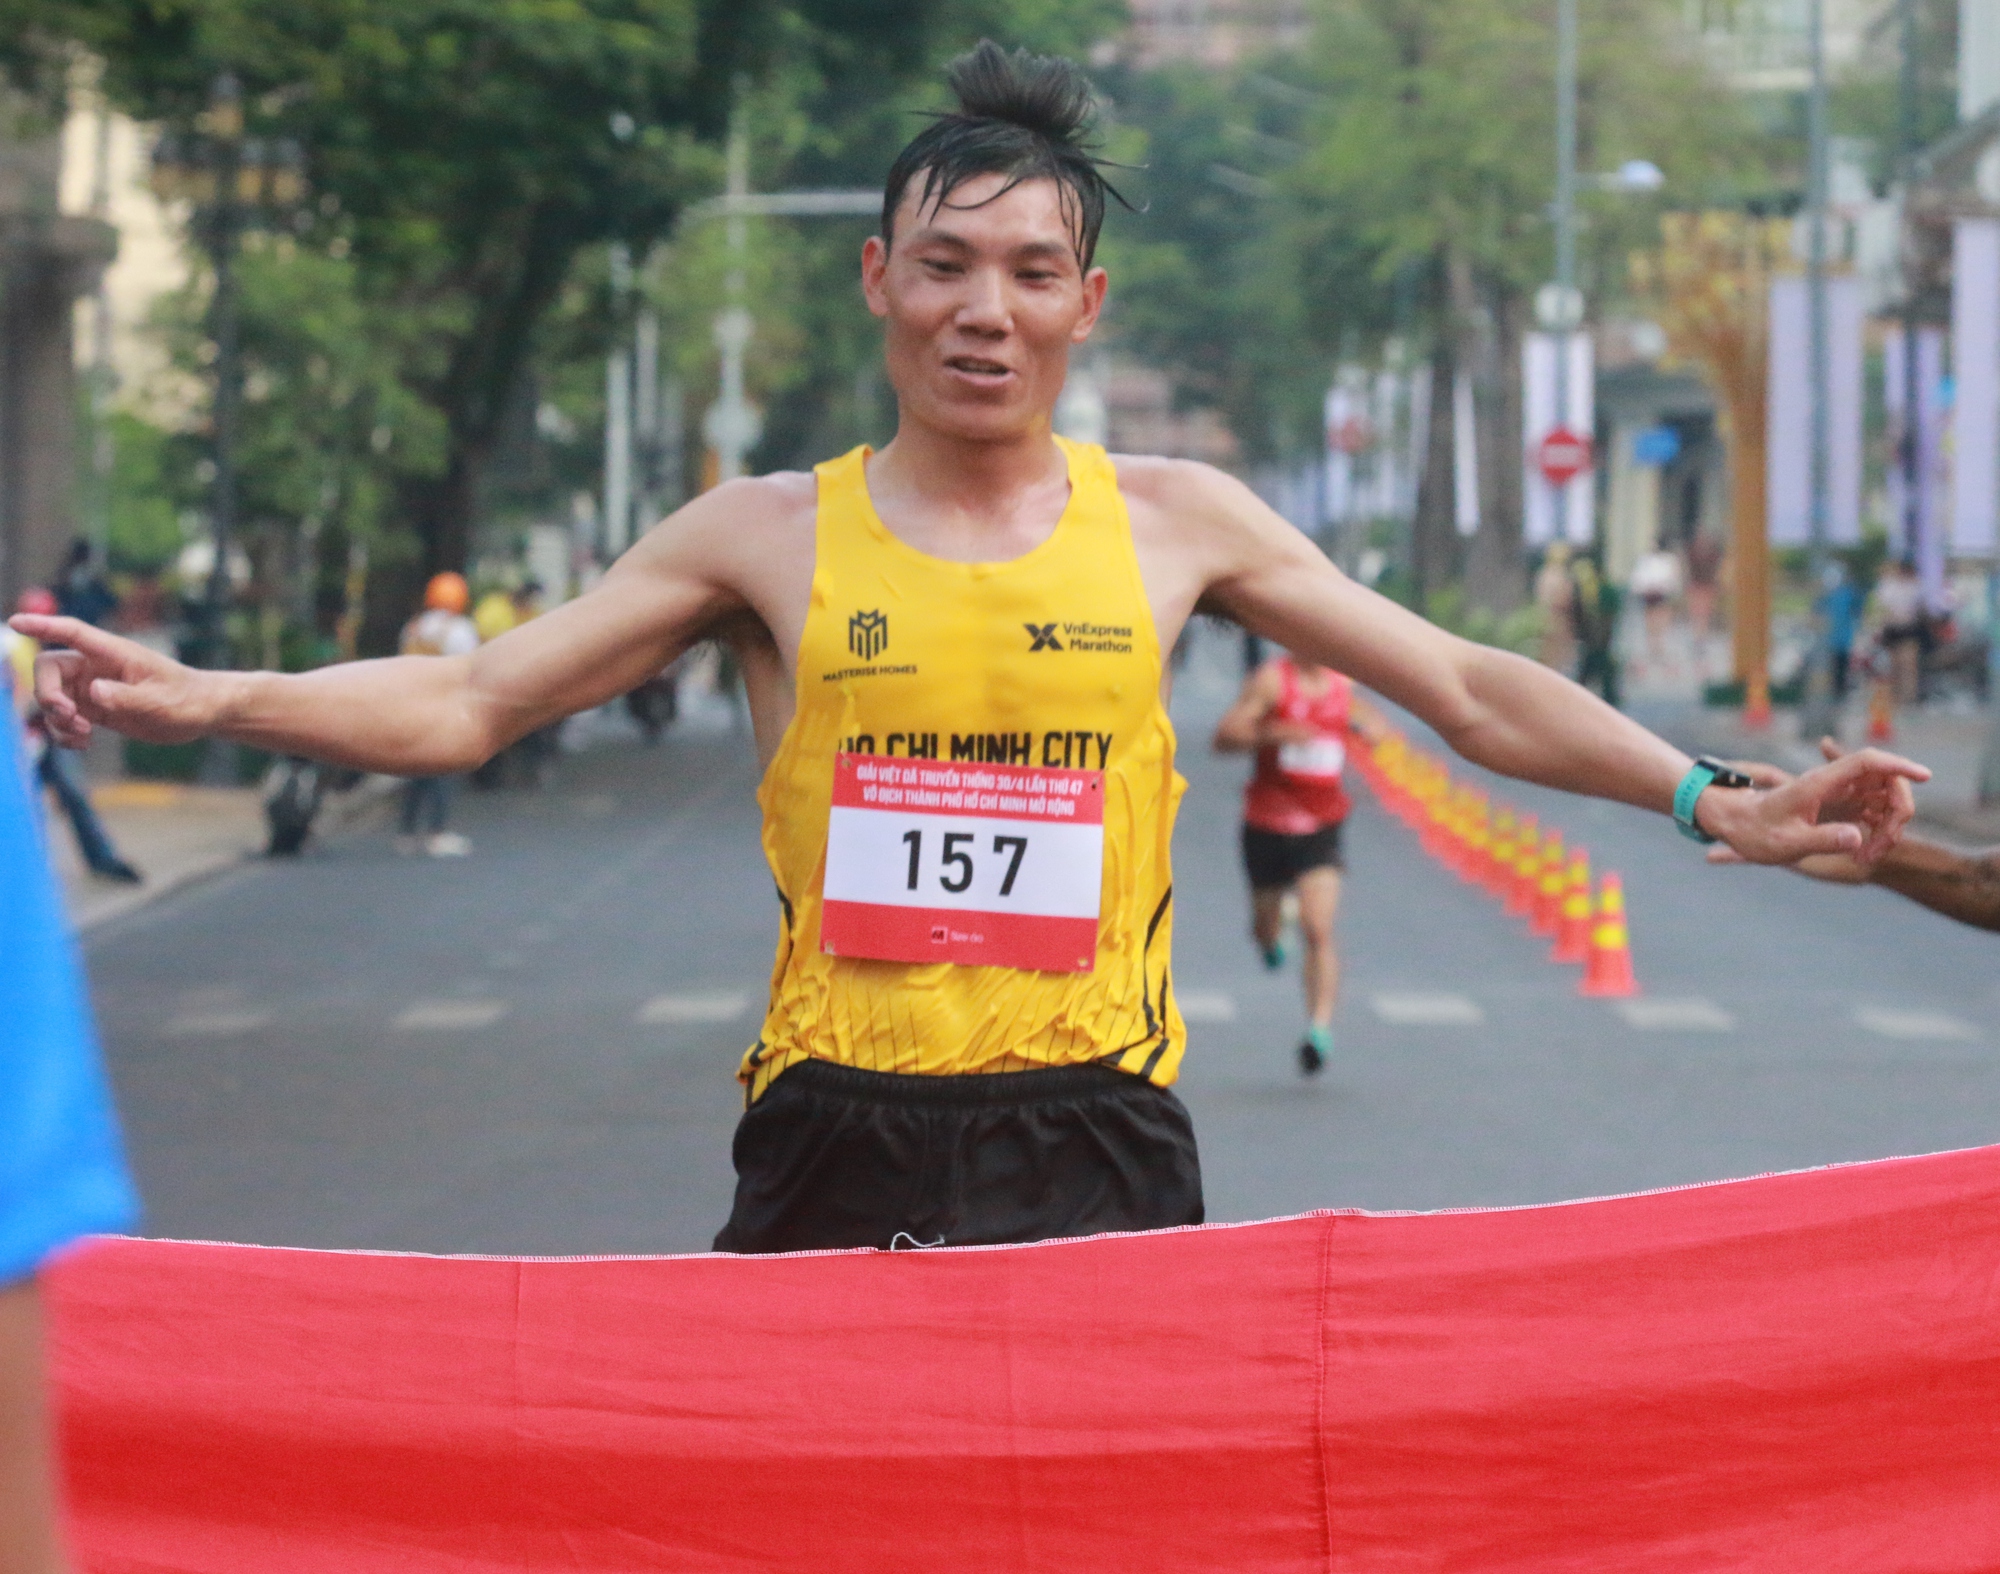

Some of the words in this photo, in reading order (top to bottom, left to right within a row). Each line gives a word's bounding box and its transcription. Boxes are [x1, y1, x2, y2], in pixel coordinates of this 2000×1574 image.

[1064, 622, 1132, 637] VnExpress
[1070, 639, 1132, 653] Marathon
[823, 666, 877, 681] MASTERISE
[879, 665, 917, 675] HOMES
[886, 732, 938, 759] CHI
[951, 732, 1031, 766] MINH
[1042, 730, 1113, 769] CITY
[1070, 779, 1083, 795] 47
[999, 796, 1027, 812] MINH
[902, 829, 1028, 897] 157
